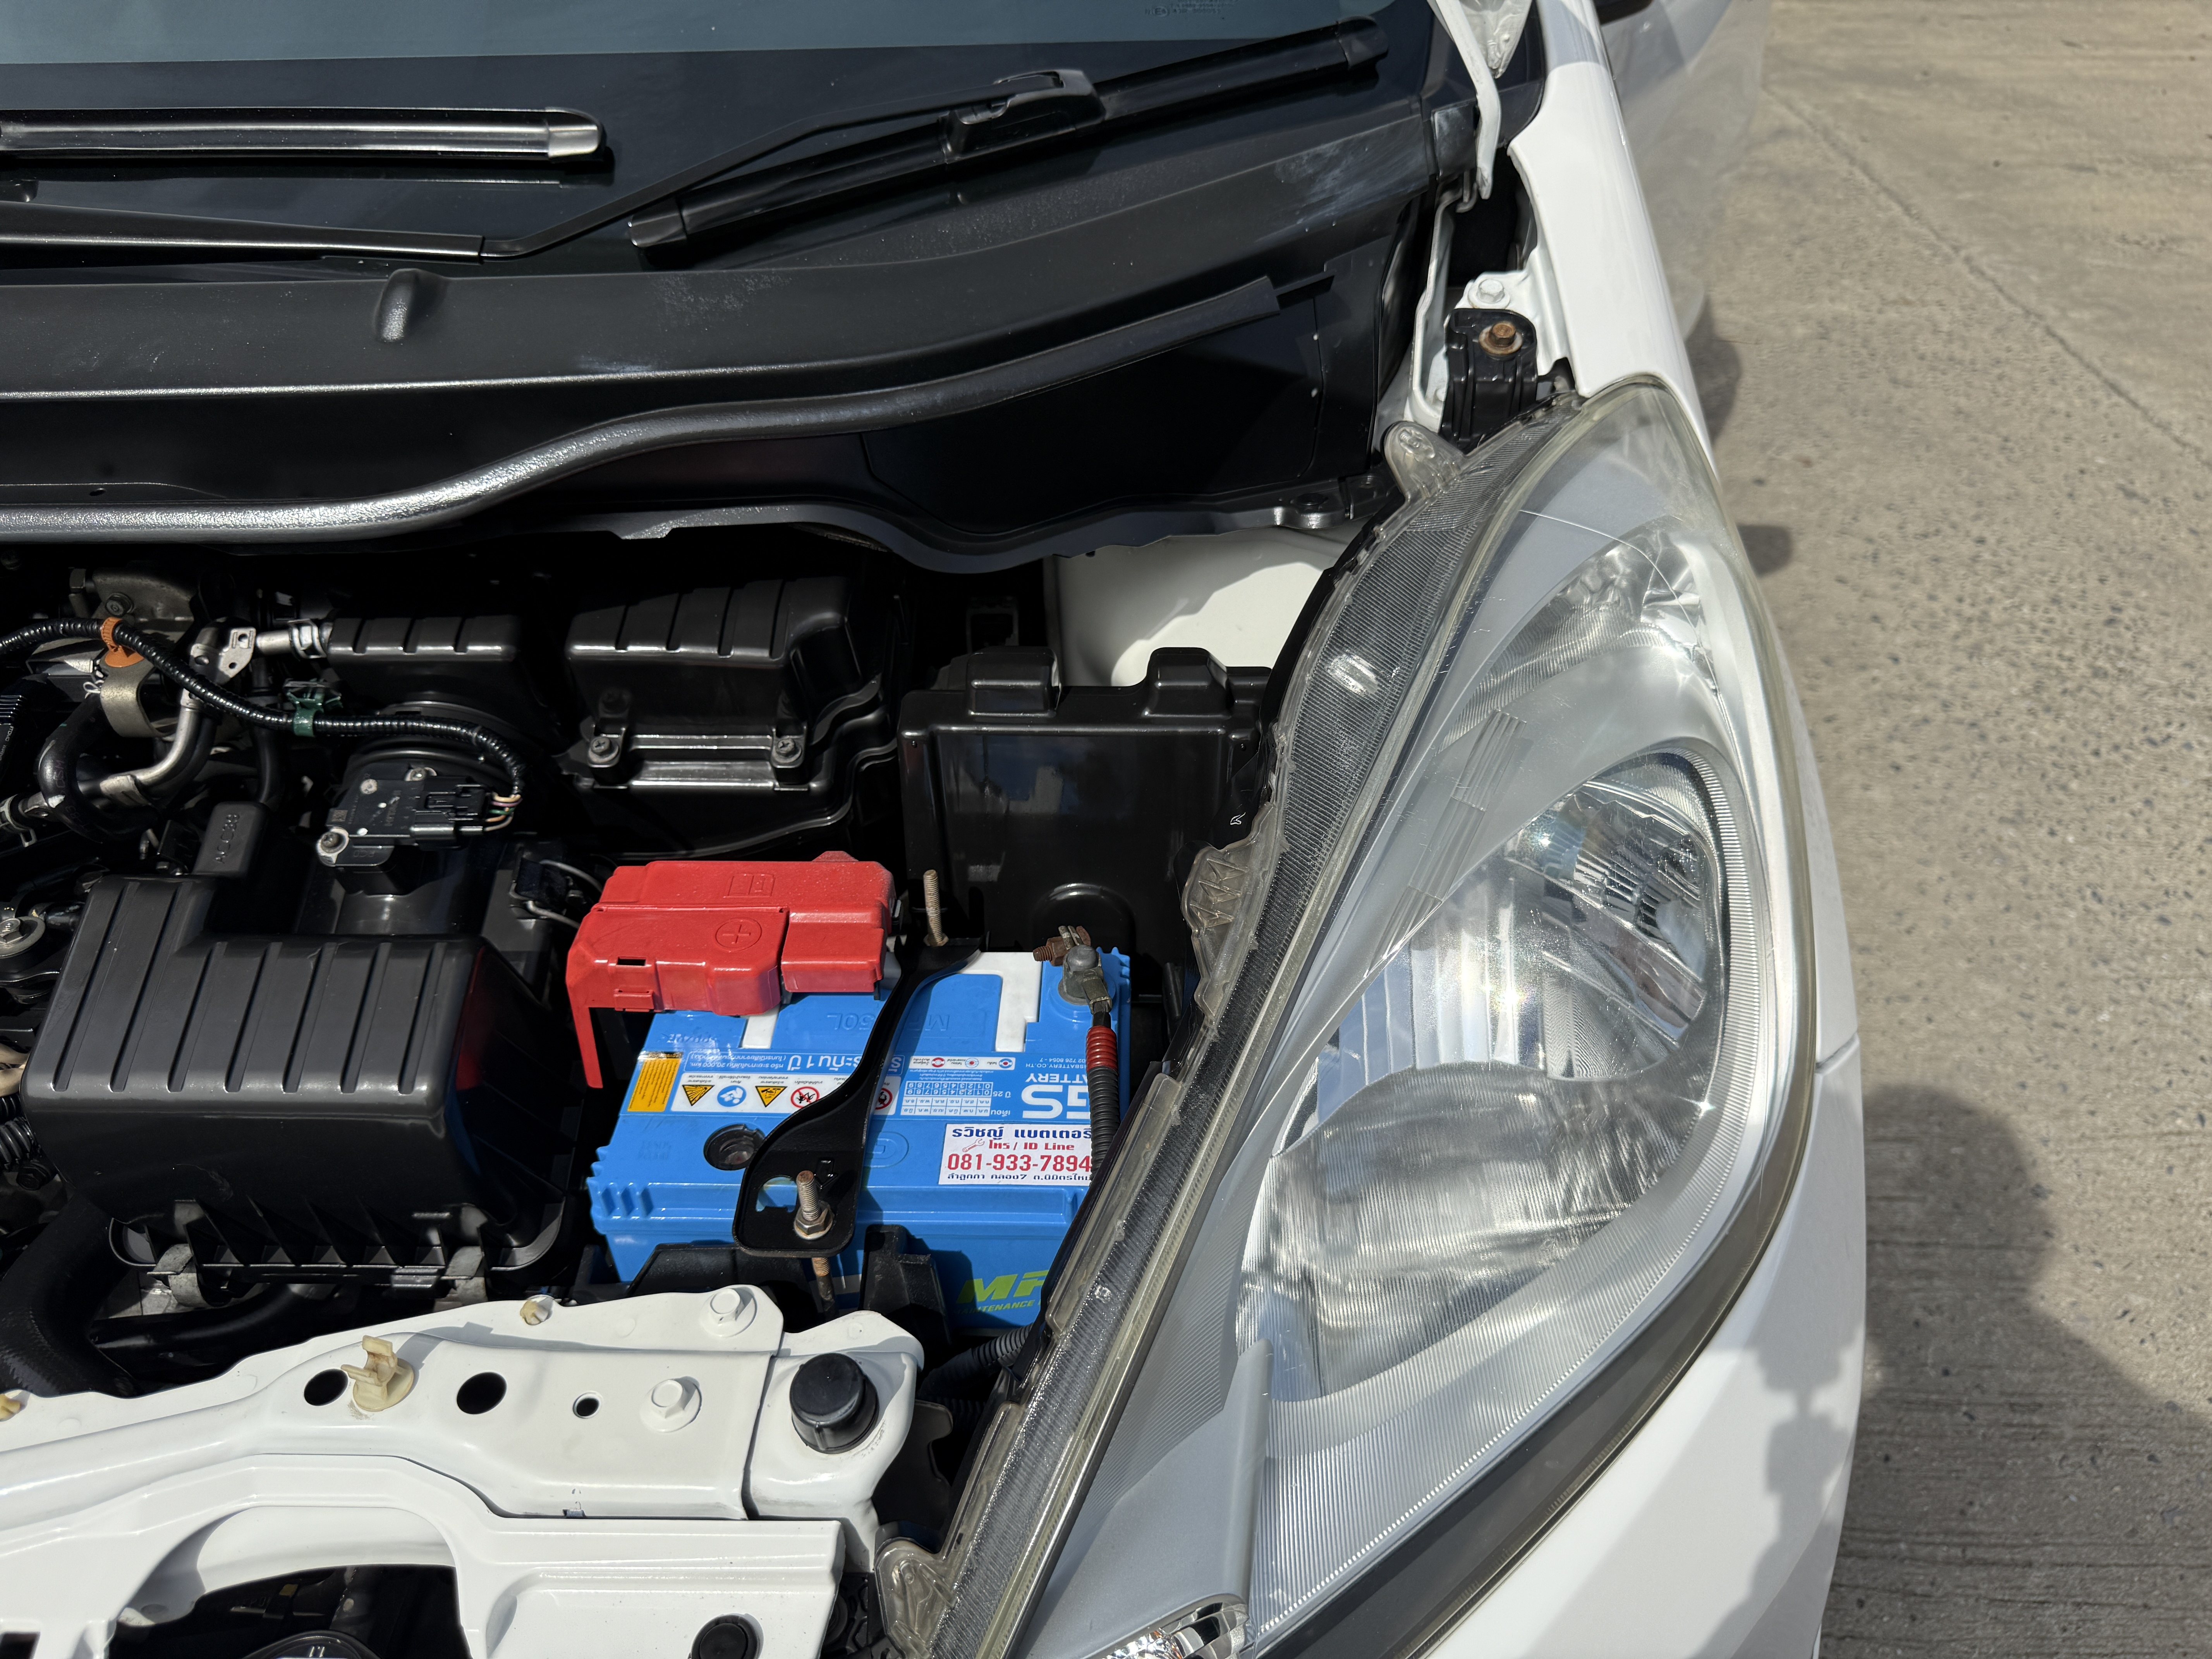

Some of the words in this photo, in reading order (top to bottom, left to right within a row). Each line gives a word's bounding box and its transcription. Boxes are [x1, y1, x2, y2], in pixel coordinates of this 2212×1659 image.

[787, 1055, 802, 1071] ปี
[807, 1056, 814, 1068] 1
[1021, 1085, 1091, 1119] GS
[952, 1127, 1004, 1140] รวิชญ์
[989, 1139, 1010, 1149] โทร
[1013, 1142, 1018, 1151] /
[947, 1153, 1092, 1172] 081-933-7894
